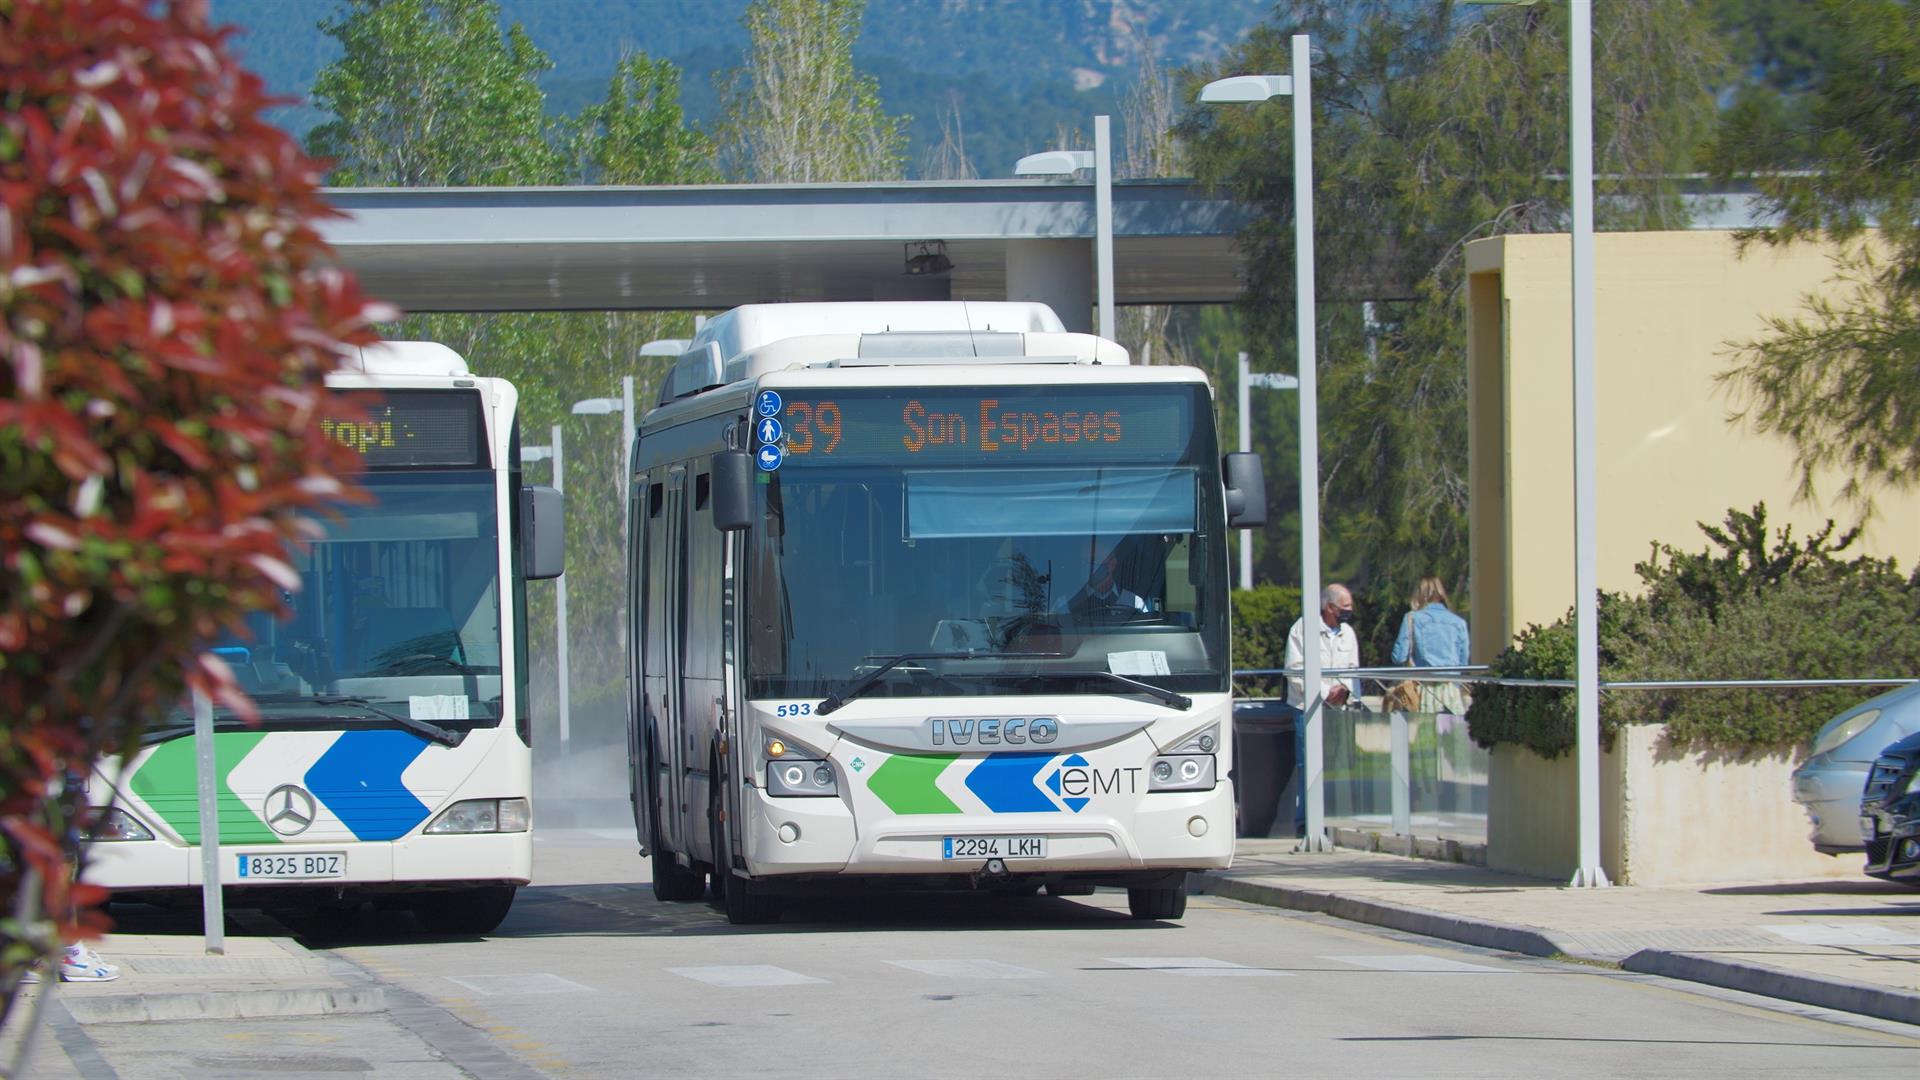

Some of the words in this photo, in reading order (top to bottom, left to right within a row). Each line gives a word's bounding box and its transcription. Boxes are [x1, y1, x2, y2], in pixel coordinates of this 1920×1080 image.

[787, 401, 841, 453] 39
[903, 400, 966, 452] Son
[980, 399, 1121, 452] Espases
[777, 703, 811, 718] 593
[932, 717, 1058, 746] IVECO
[955, 839, 999, 856] 2294
[1008, 838, 1041, 856] LKH
[252, 857, 297, 875] 8325
[304, 856, 339, 874] BDZ
